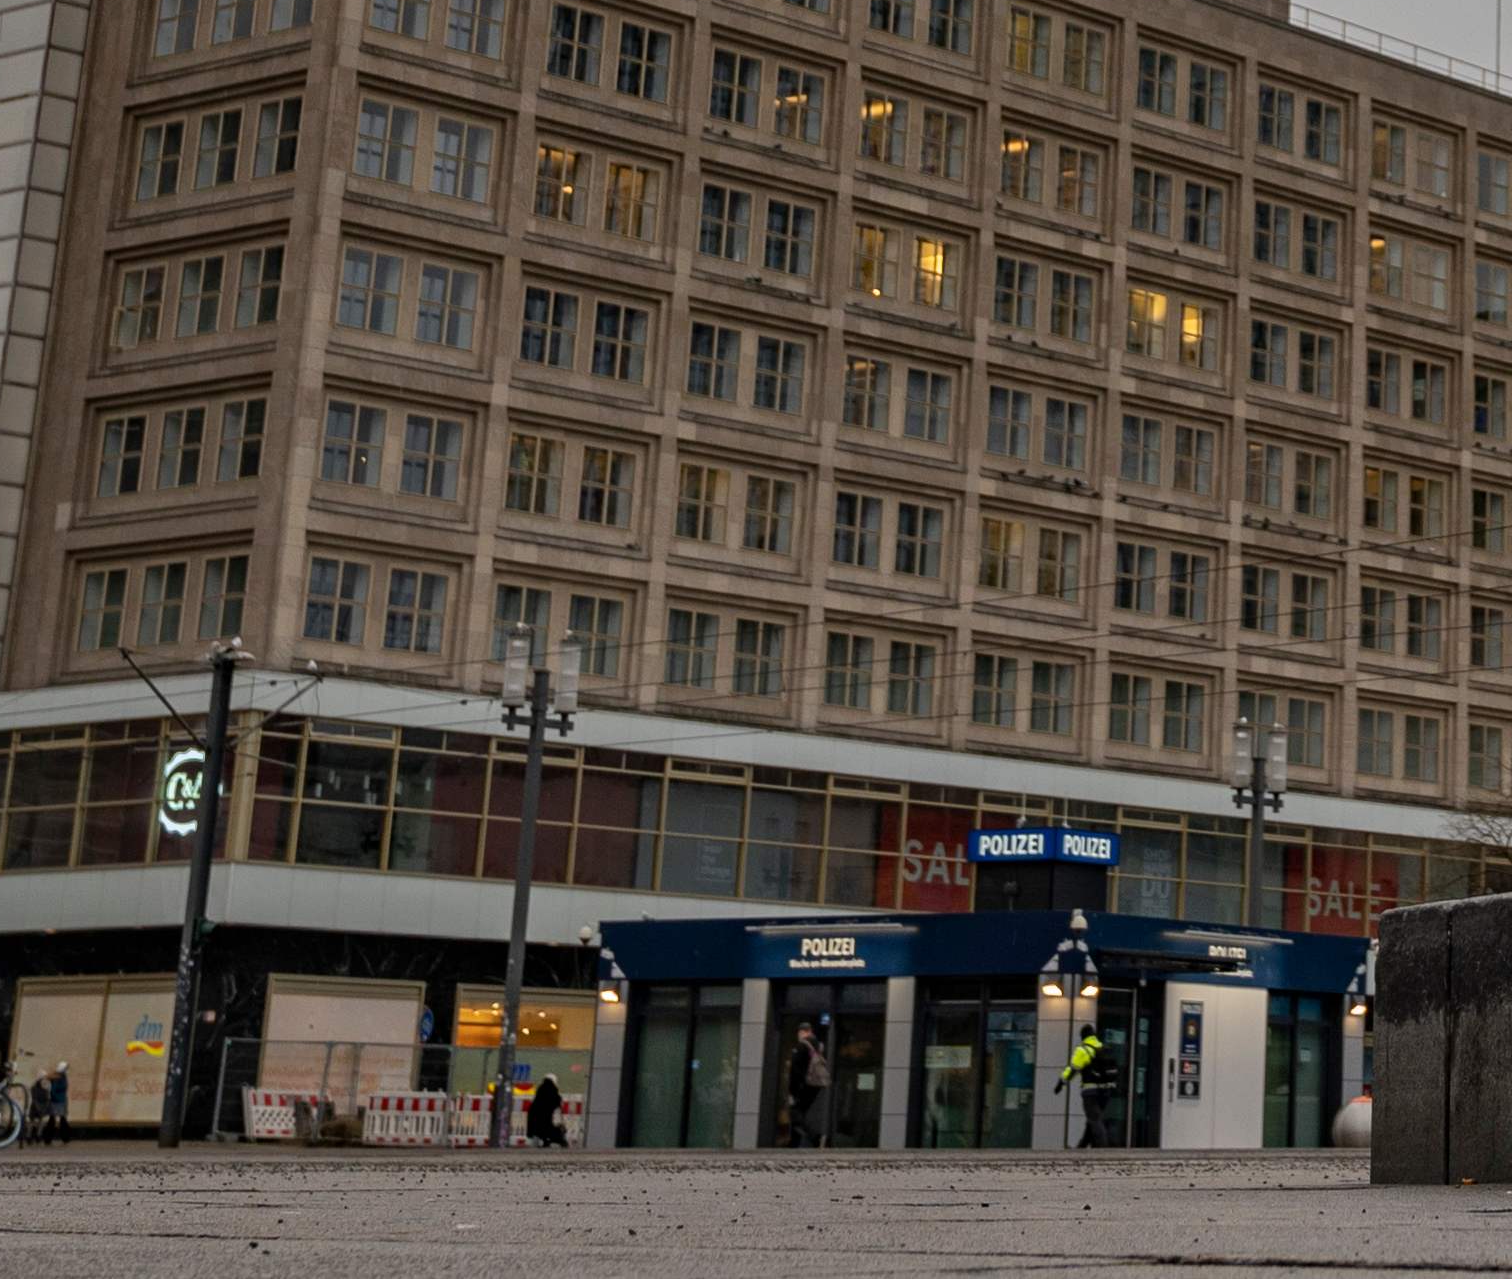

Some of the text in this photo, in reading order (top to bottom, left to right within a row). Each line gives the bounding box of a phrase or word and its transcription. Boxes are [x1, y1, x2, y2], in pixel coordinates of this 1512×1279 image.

[979, 834, 1044, 856] POLIZEI
[1063, 834, 1111, 859] POLIZEI
[903, 839, 969, 886] SAL
[1306, 877, 1381, 921] SALE
[801, 938, 855, 957] POLIZEI
[134, 1014, 163, 1041] dm
